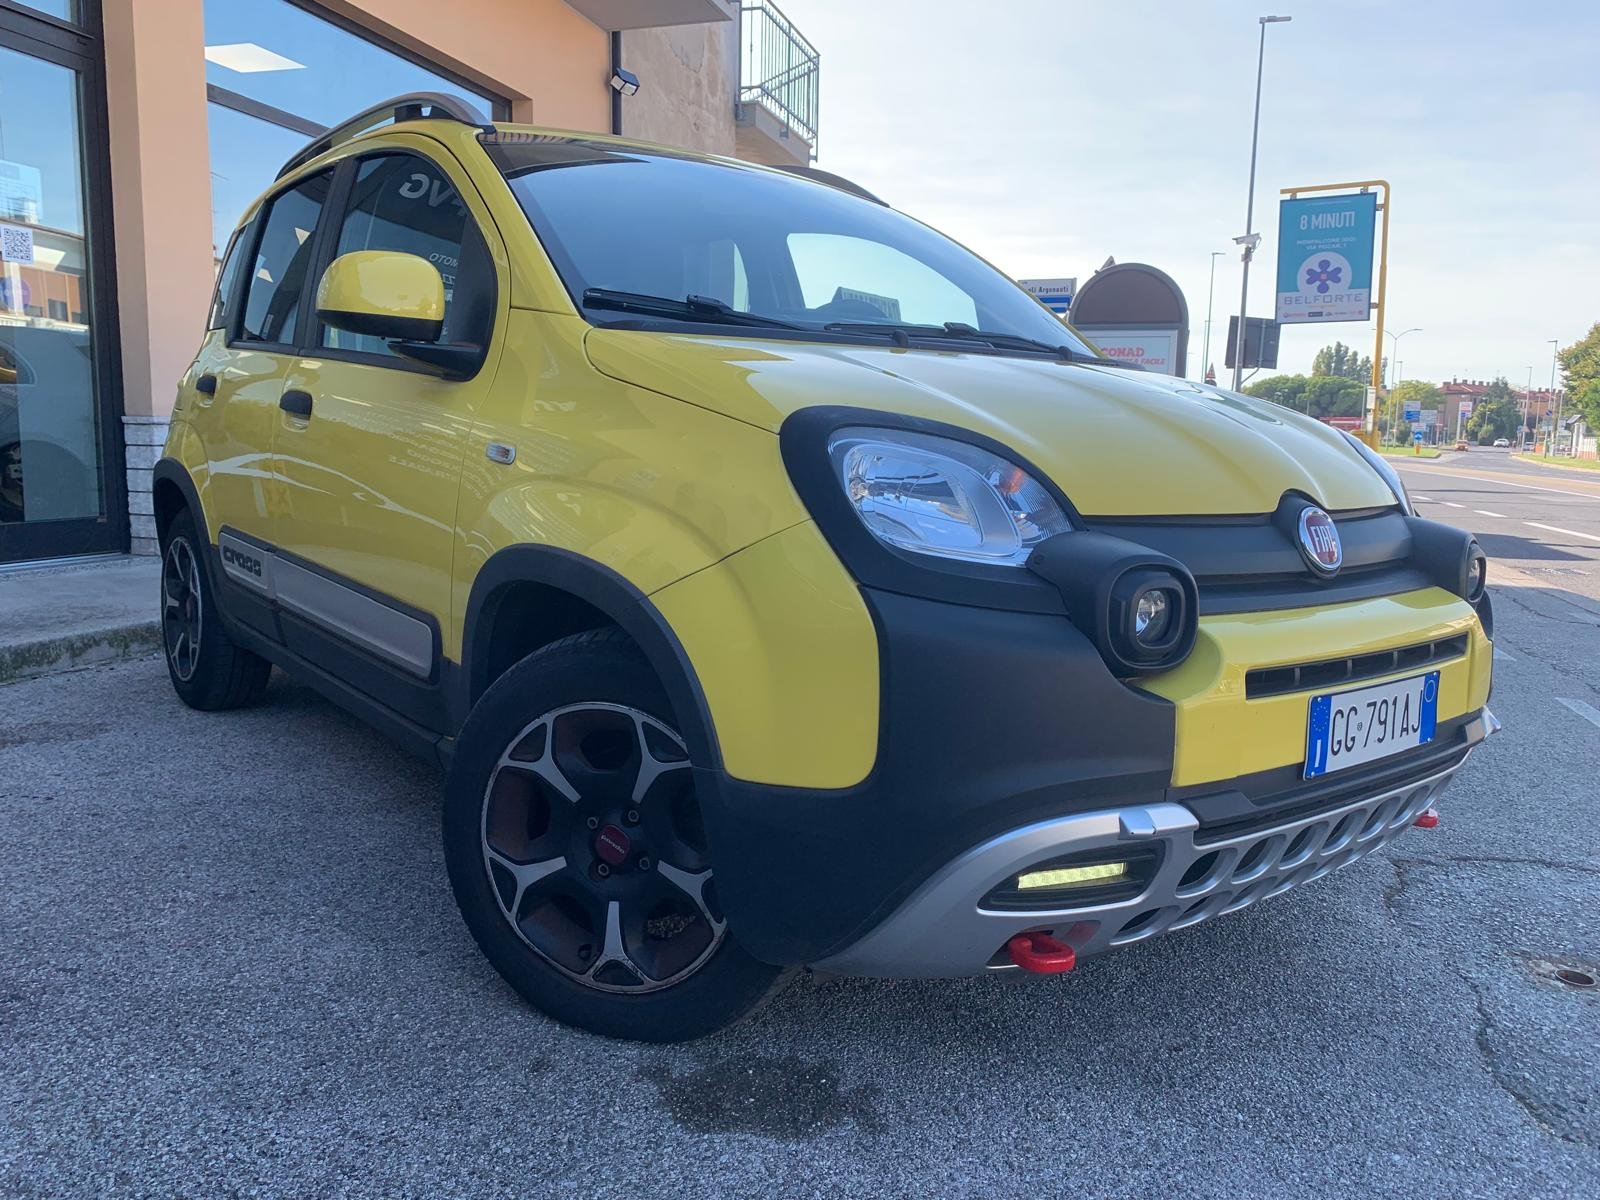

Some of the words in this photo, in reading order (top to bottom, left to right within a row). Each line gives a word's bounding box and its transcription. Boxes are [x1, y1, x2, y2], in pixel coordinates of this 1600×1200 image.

[1300, 214, 1308, 230] 8
[1311, 212, 1355, 230] MINUTI
[1038, 286, 1069, 294] Argonauti
[1284, 294, 1363, 305] BELFORTE
[1310, 525, 1337, 555] FIAT
[222, 545, 262, 577] cross
[1331, 706, 1358, 756] GG
[1363, 689, 1423, 748] 791AJ
